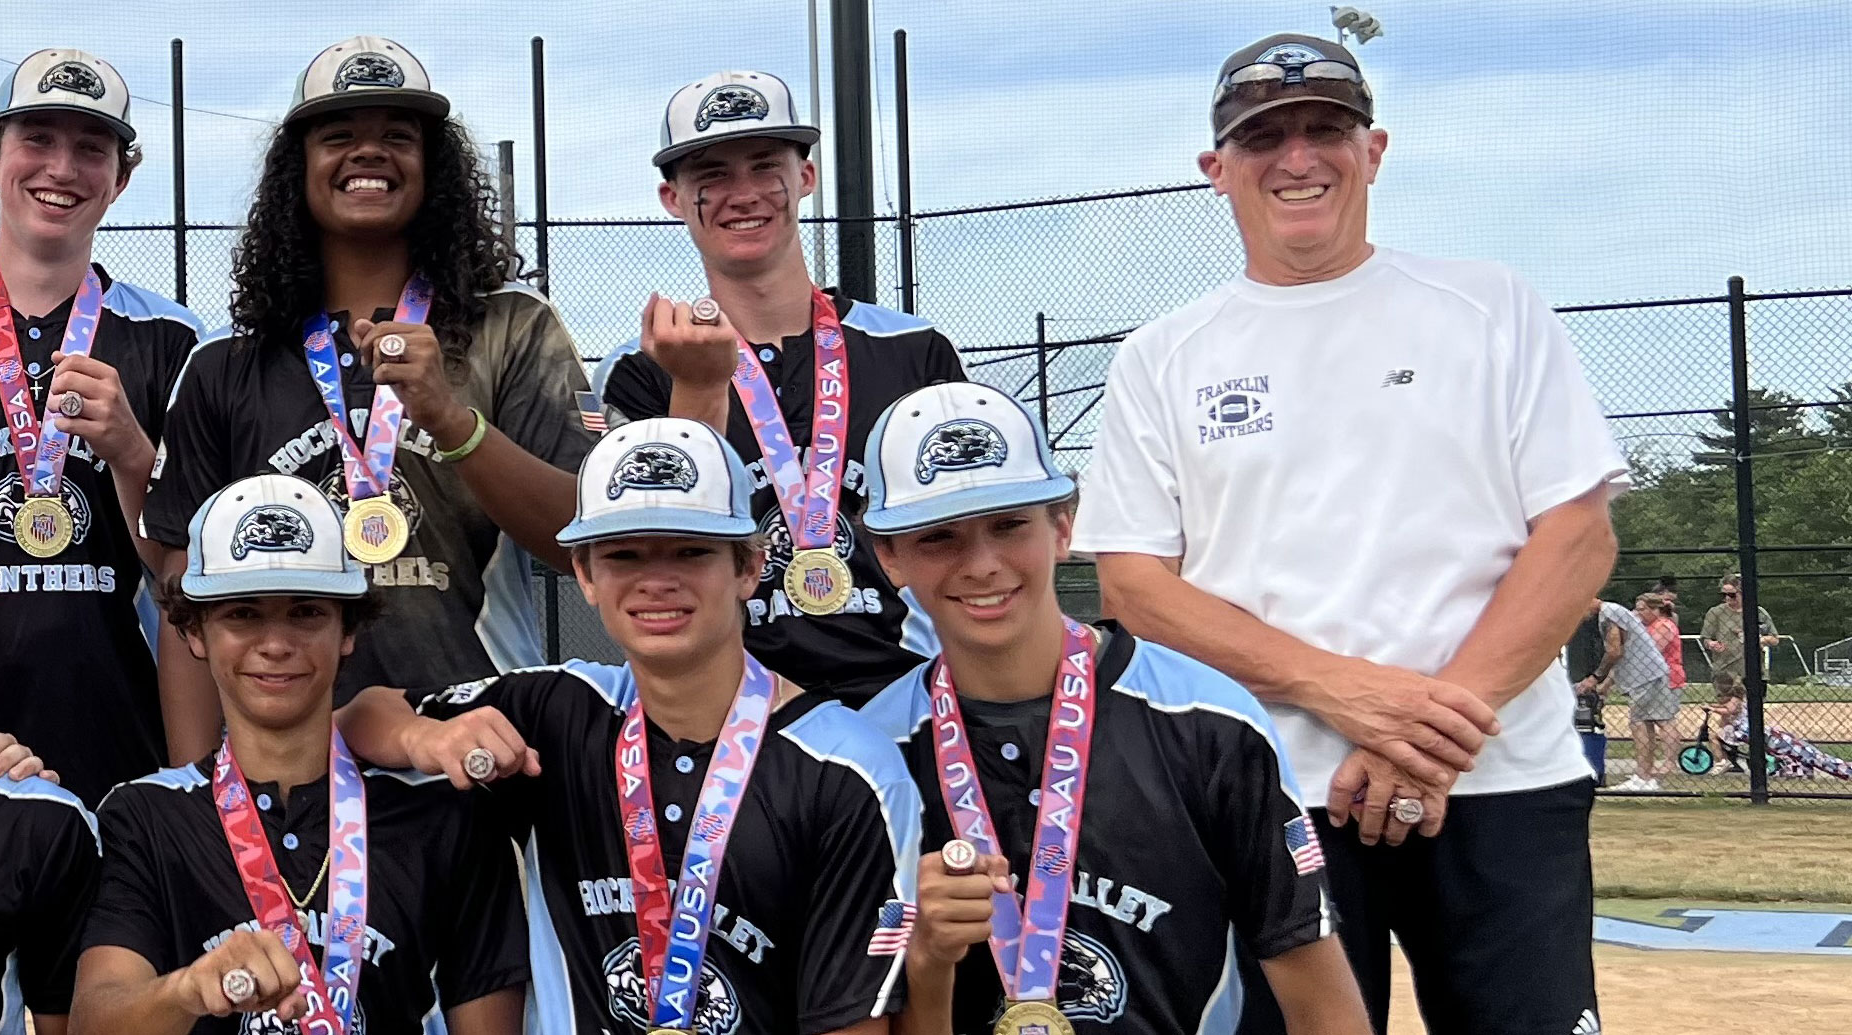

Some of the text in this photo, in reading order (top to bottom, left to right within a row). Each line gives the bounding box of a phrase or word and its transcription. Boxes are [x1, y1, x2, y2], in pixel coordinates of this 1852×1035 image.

[10, 389, 37, 453] USA
[812, 359, 843, 502] AAU USA
[1196, 375, 1269, 407] FRANKLIN
[1198, 412, 1274, 444] PANTHERS
[622, 718, 642, 798] USA
[936, 664, 990, 841] AAU USA
[1048, 651, 1089, 833] AAU USA
[676, 860, 712, 940] USA
